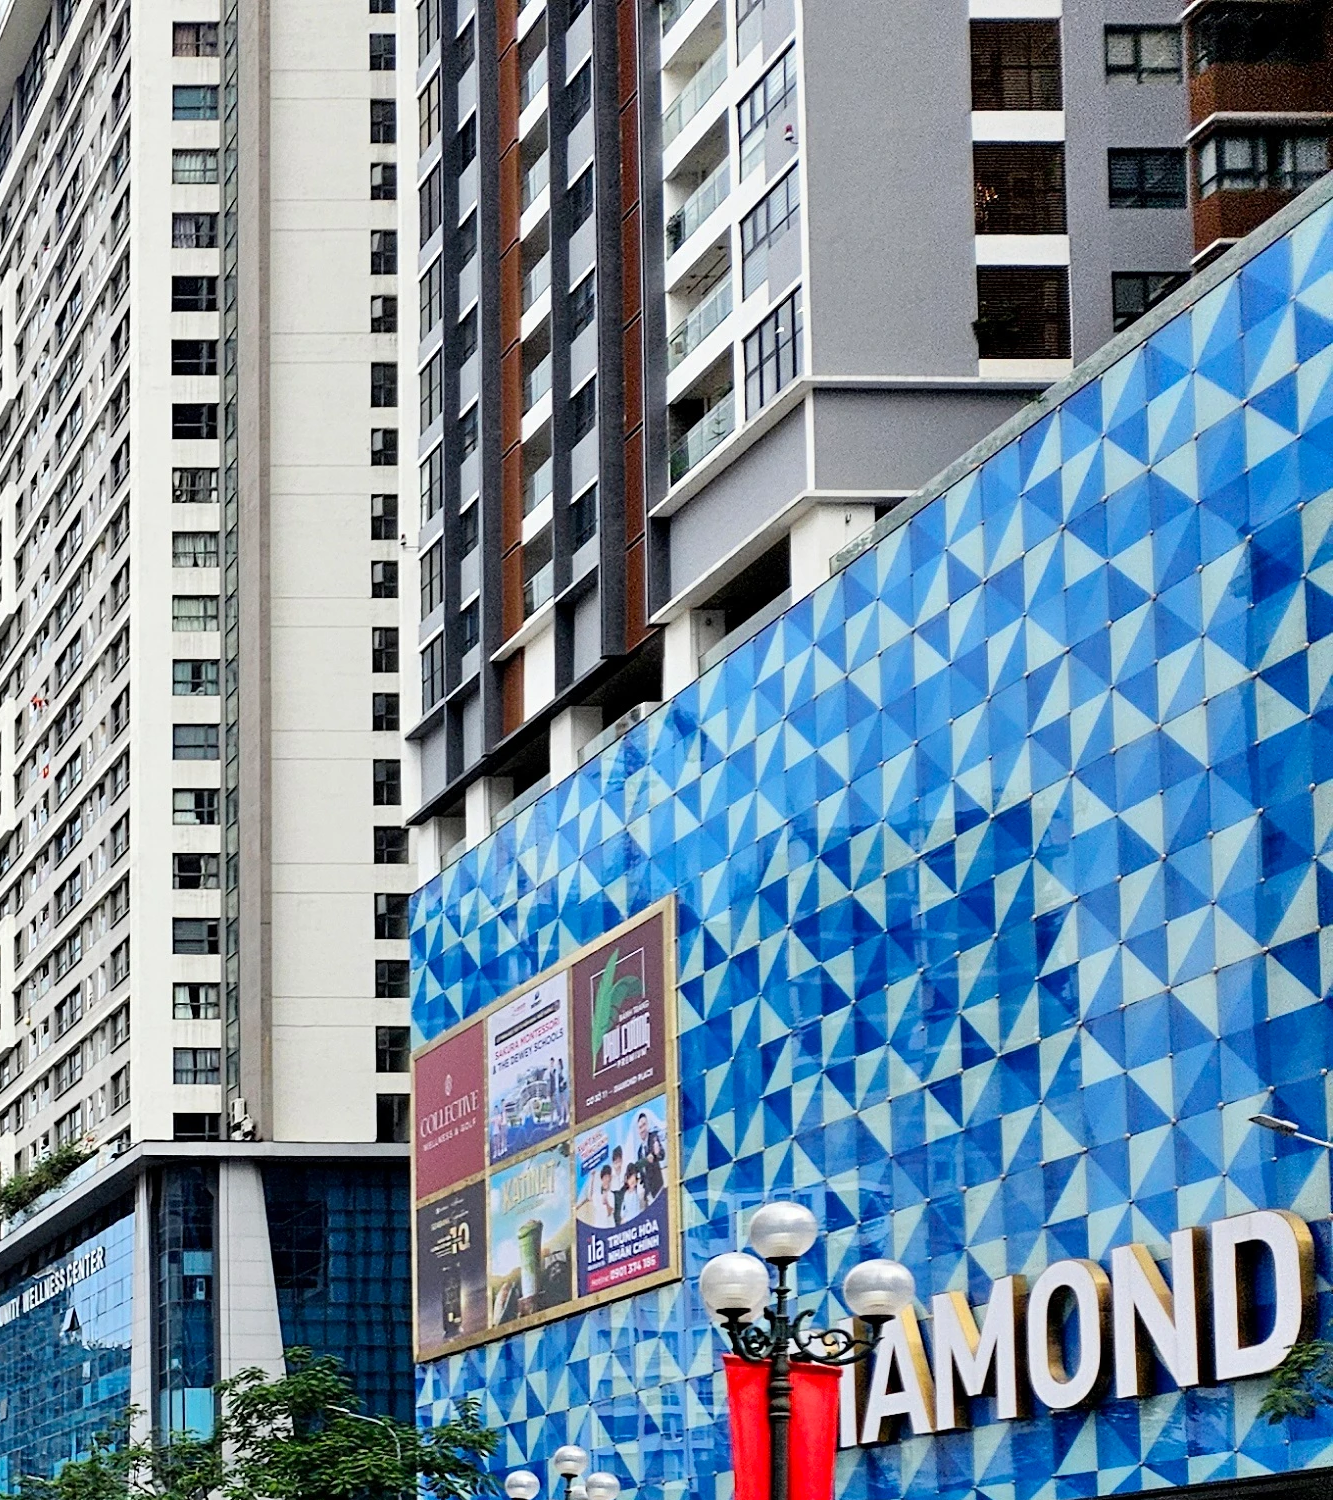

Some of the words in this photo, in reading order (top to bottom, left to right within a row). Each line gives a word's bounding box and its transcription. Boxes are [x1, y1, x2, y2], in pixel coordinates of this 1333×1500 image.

[495, 1040, 519, 1060] SAKURA
[520, 1017, 560, 1044] MONTESSORI
[510, 1046, 533, 1066] DEWEY
[533, 1027, 564, 1053] SCHOOLS
[420, 1089, 479, 1138] COLLECTIVE
[423, 1129, 453, 1152] WELLNESS
[587, 1234, 605, 1264] ila
[607, 1227, 638, 1249] TRUNG
[639, 1219, 659, 1238] HÒA
[608, 1244, 632, 1264] NHÂN
[633, 1234, 660, 1255] CHÍNH
[22, 1265, 66, 1314] WELLNESS
[66, 1246, 106, 1288] CENTER
[792, 1210, 1305, 1449] IAMOND
